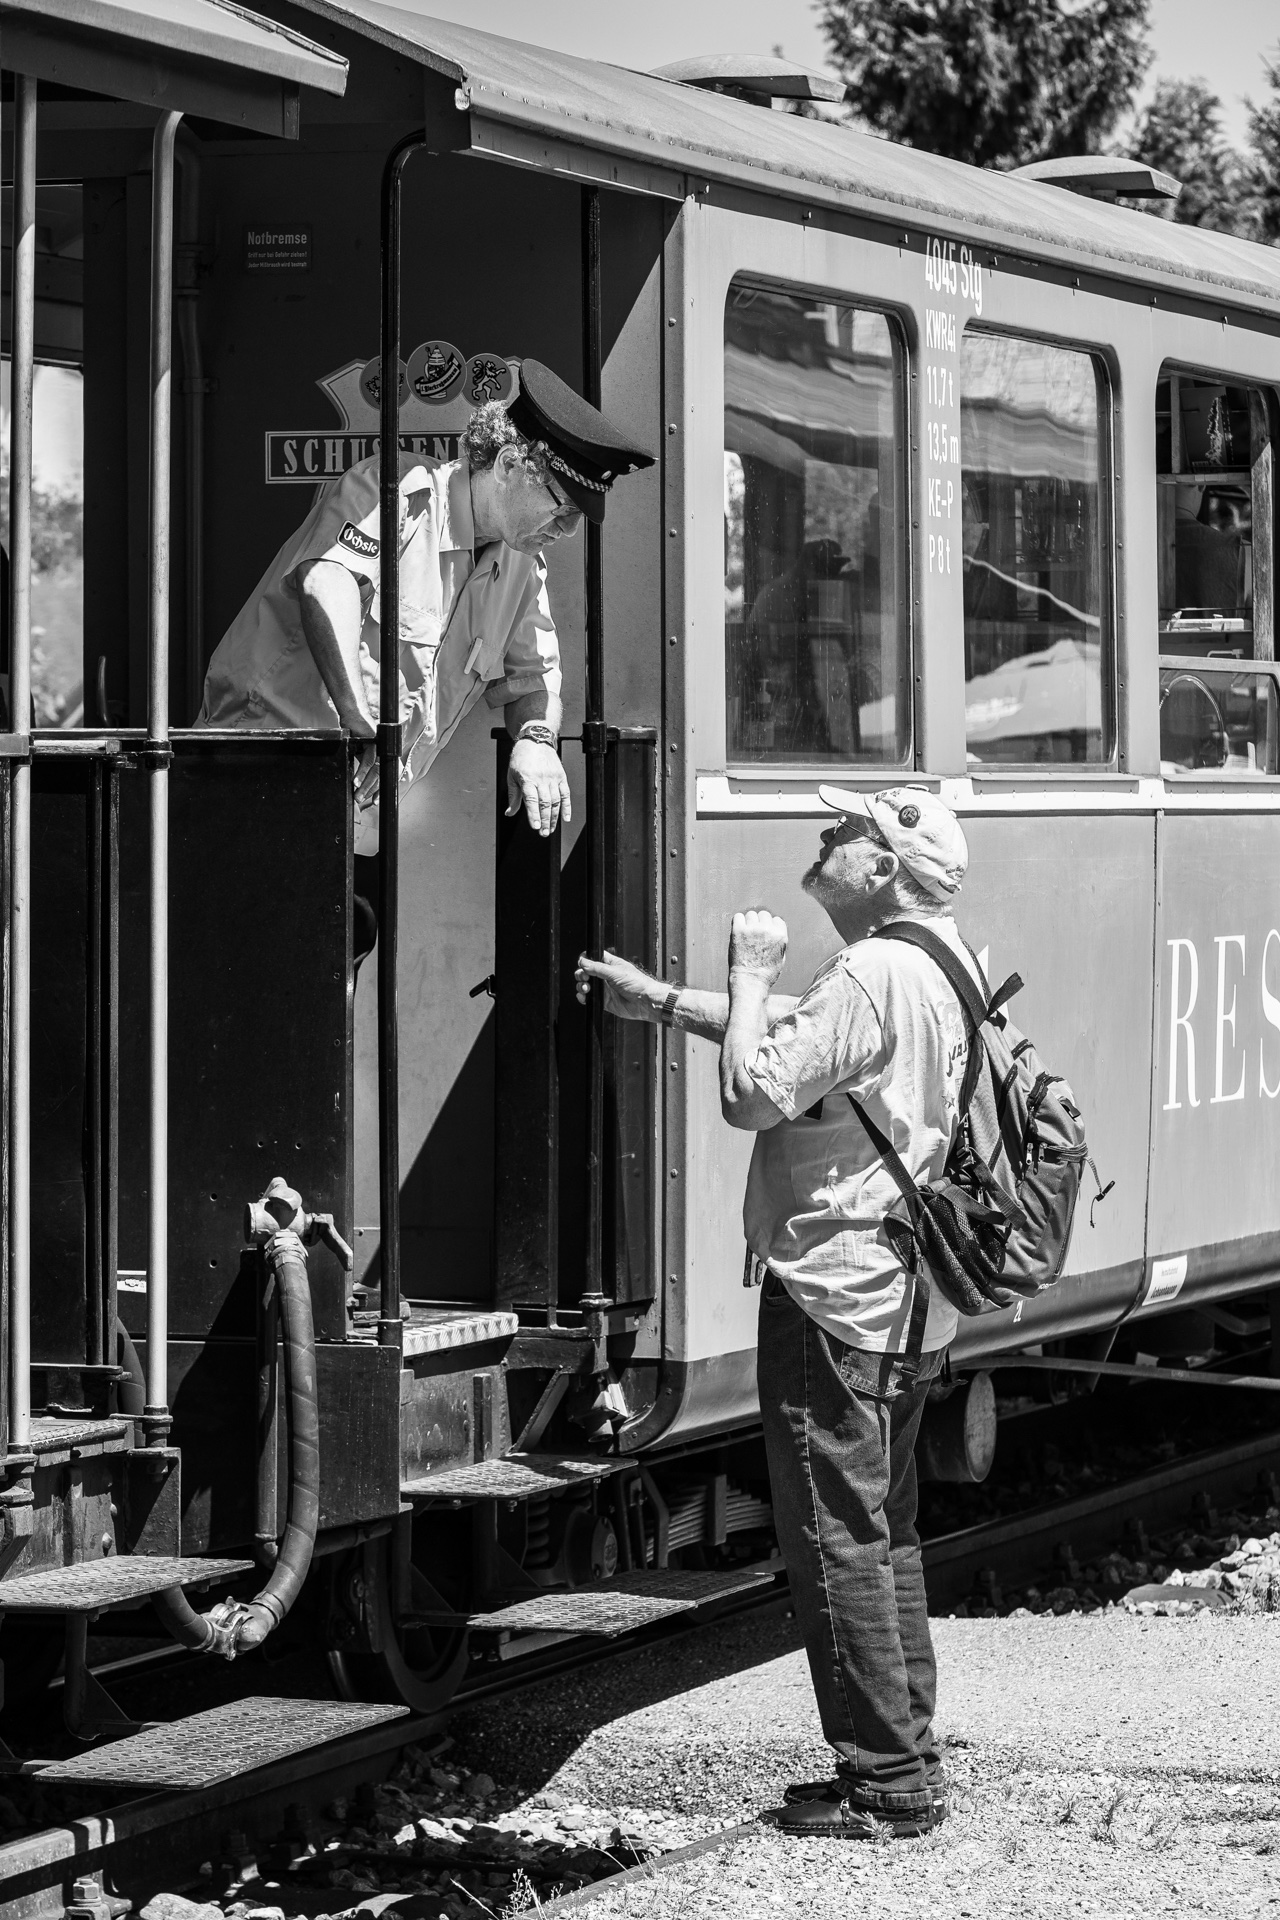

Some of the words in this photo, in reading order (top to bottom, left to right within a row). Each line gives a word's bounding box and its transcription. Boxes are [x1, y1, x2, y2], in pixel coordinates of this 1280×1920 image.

[247, 231, 308, 246] Notbremse
[925, 235, 957, 295] 4045
[960, 244, 983, 317] Stg
[925, 308, 957, 353] KWR4i
[926, 365, 947, 409] 11,7
[948, 370, 954, 408] t
[927, 421, 948, 465] 13,5
[949, 435, 959, 464] m
[928, 477, 954, 519] KE-P
[343, 526, 378, 554] Öchsle
[928, 534, 936, 573] P
[937, 534, 944, 574] 8
[945, 538, 951, 575] t
[1162, 928, 1280, 1111] RES
